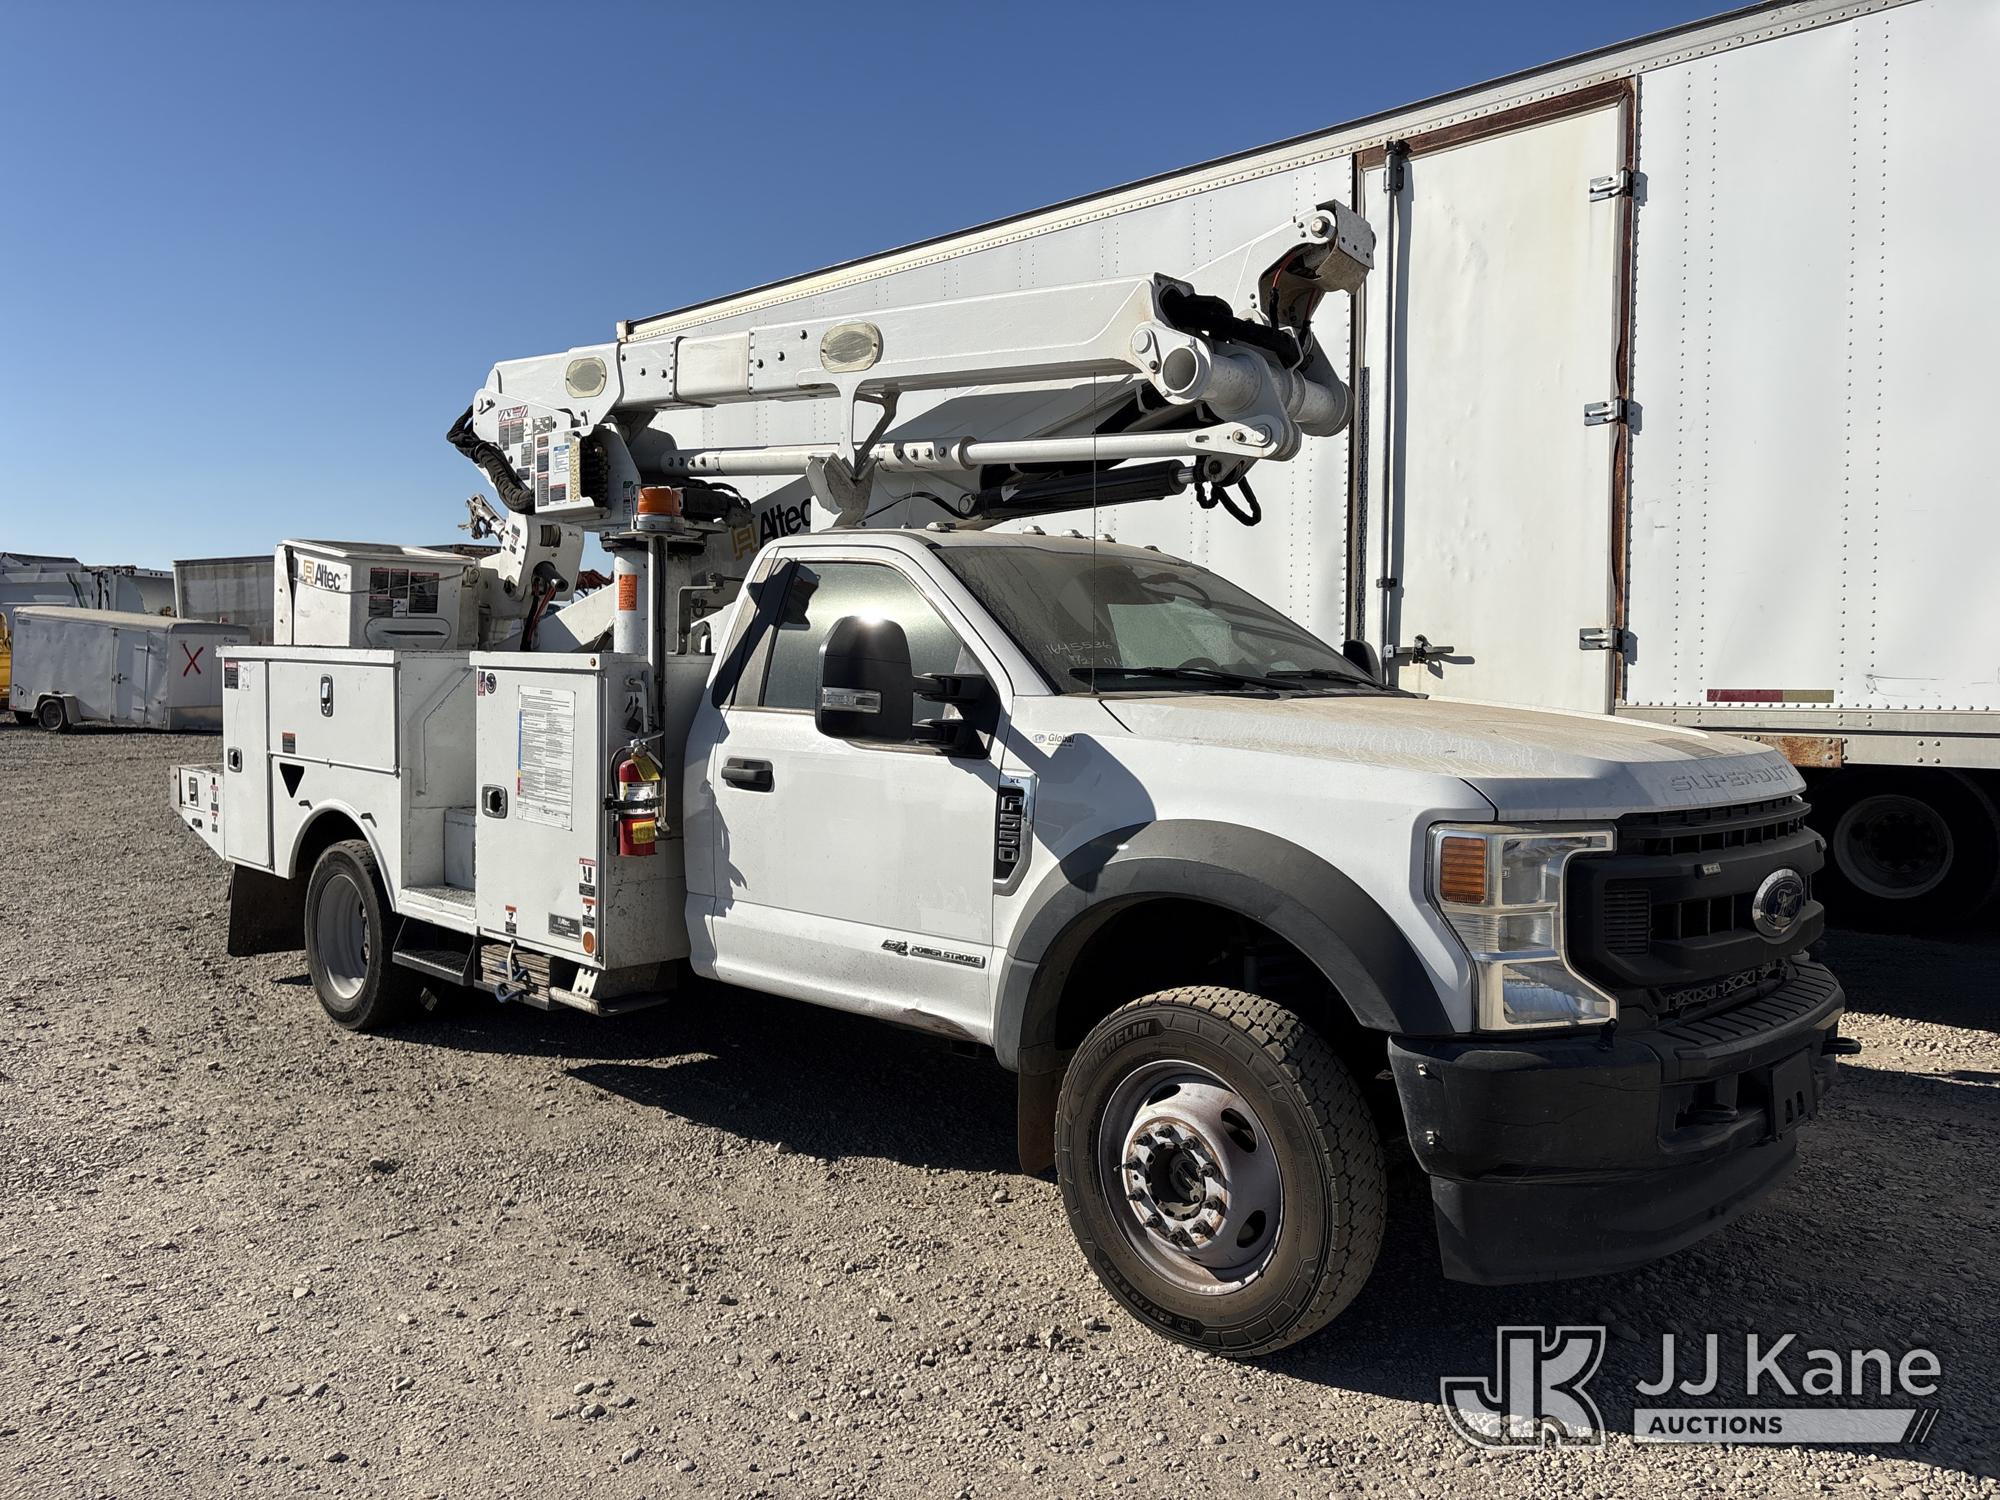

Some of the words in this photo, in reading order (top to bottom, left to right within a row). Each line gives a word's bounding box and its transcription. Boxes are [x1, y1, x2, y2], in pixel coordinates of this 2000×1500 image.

[764, 499, 819, 554] Altec
[314, 563, 341, 591] Altec
[1048, 733, 1075, 743] Global
[912, 945, 942, 958] POWER
[944, 951, 981, 964] STROKE
